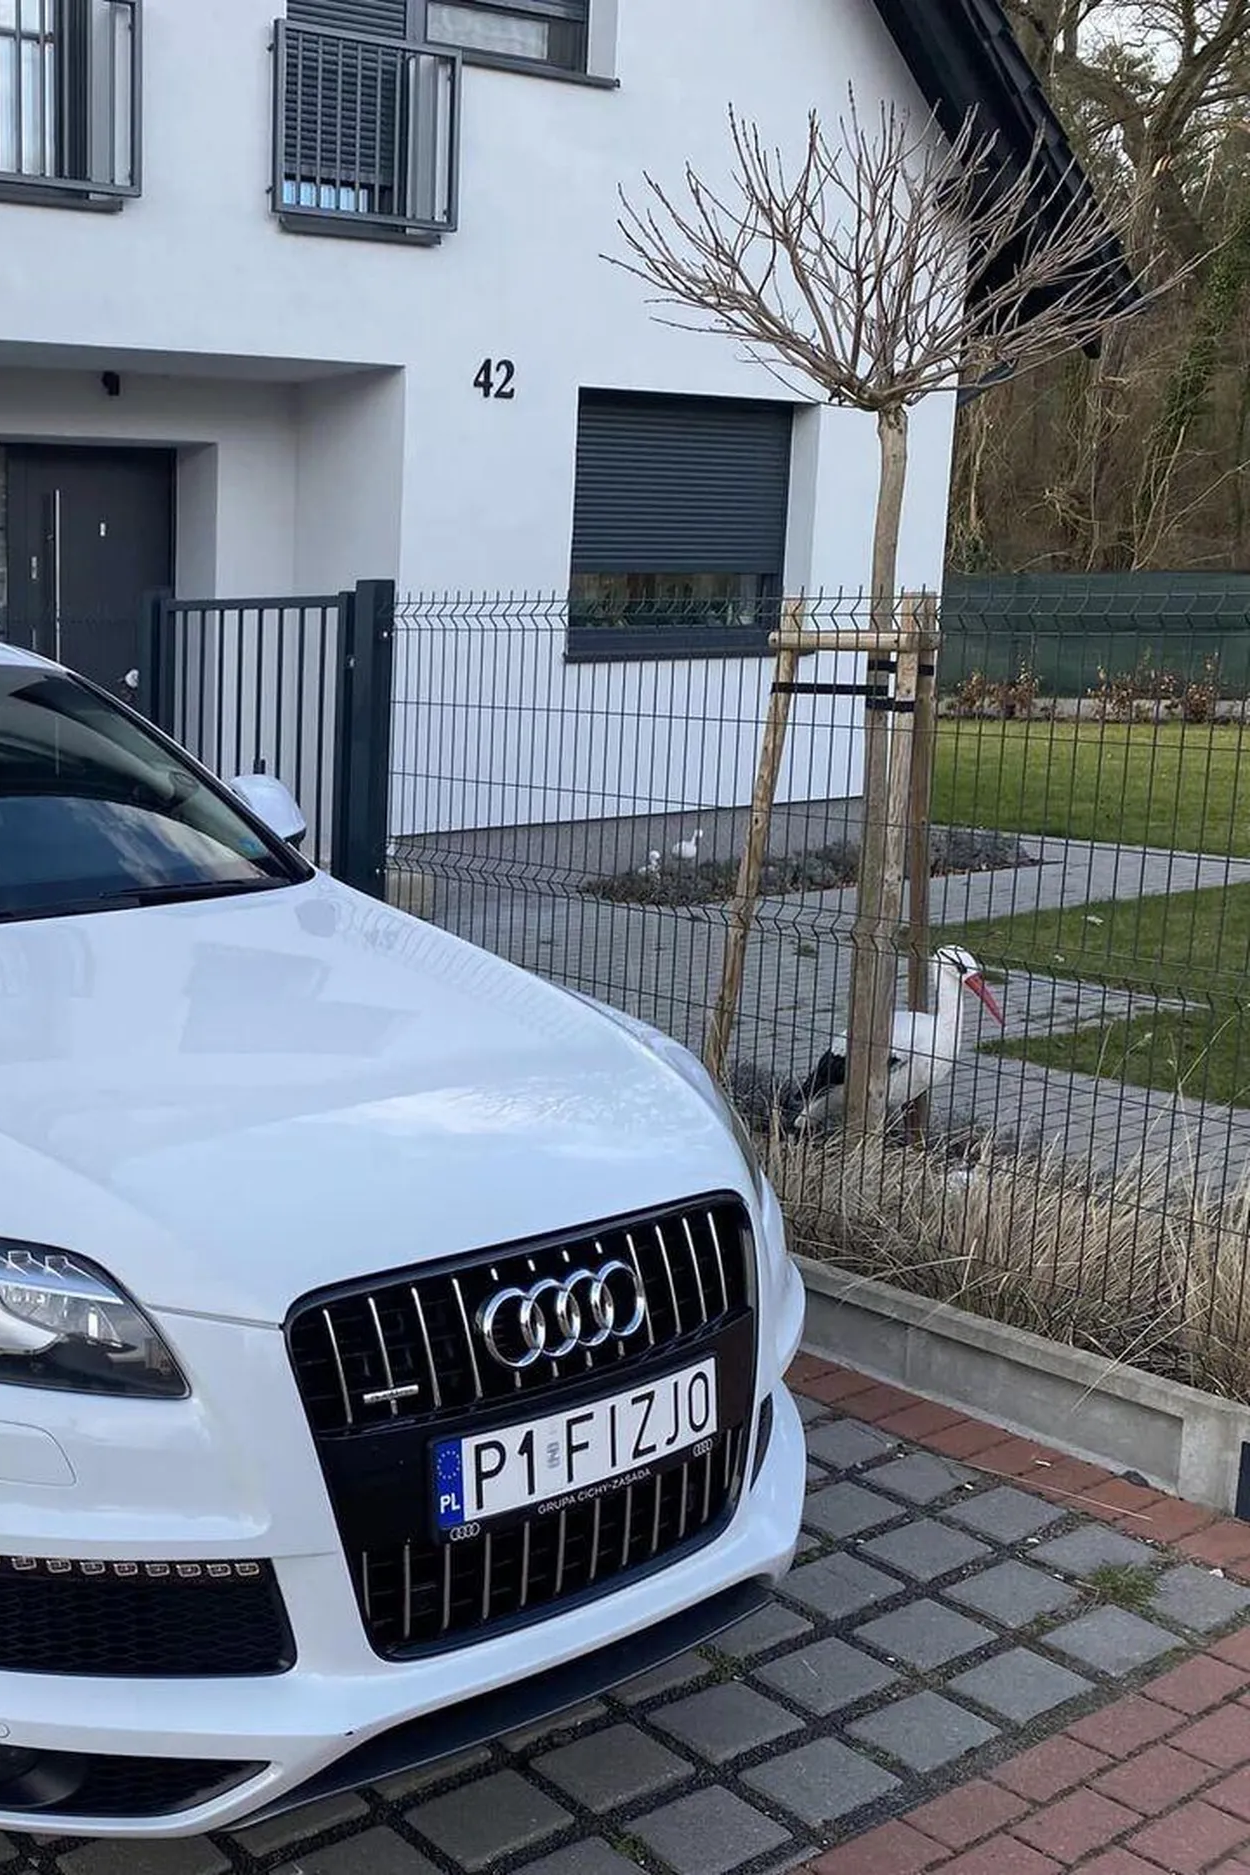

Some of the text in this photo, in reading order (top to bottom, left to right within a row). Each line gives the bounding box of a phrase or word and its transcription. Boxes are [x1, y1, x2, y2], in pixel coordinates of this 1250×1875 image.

[473, 358, 515, 399] 42
[439, 1494, 461, 1515] PL
[537, 1495, 577, 1515] GRUPA
